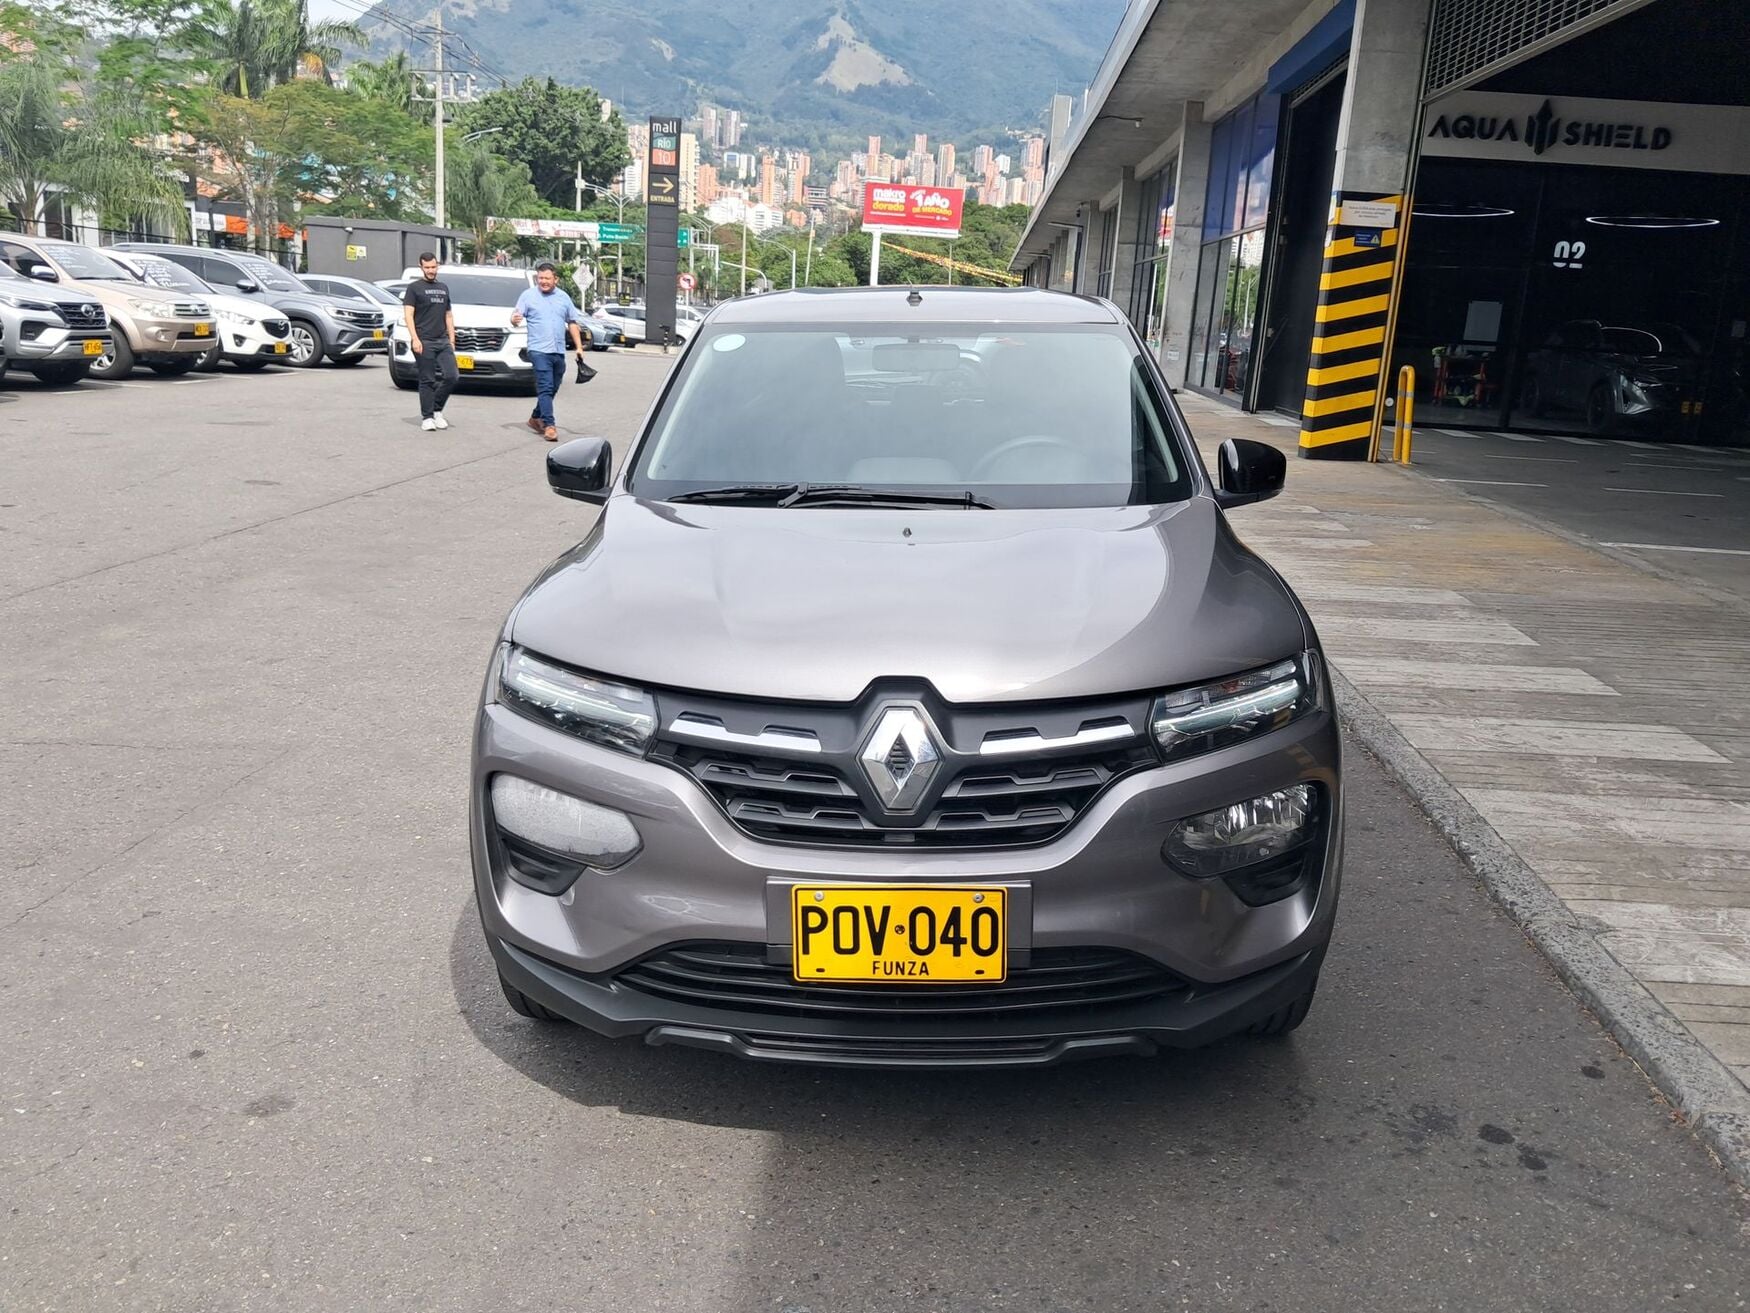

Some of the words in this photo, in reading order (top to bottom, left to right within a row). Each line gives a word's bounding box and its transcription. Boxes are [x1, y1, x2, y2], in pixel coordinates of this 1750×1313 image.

[652, 121, 677, 134] mall
[1428, 114, 1519, 142] AQUA
[1562, 120, 1672, 151] SHIELD
[656, 152, 671, 165] 10
[650, 195, 675, 204] ENTRADA
[873, 188, 906, 199] makro
[872, 201, 905, 212] dorado
[914, 193, 923, 207] 1
[924, 192, 950, 209] AÑO
[922, 206, 953, 216] MERCADO
[1552, 240, 1586, 269] 02
[872, 960, 929, 976] FUNZA
